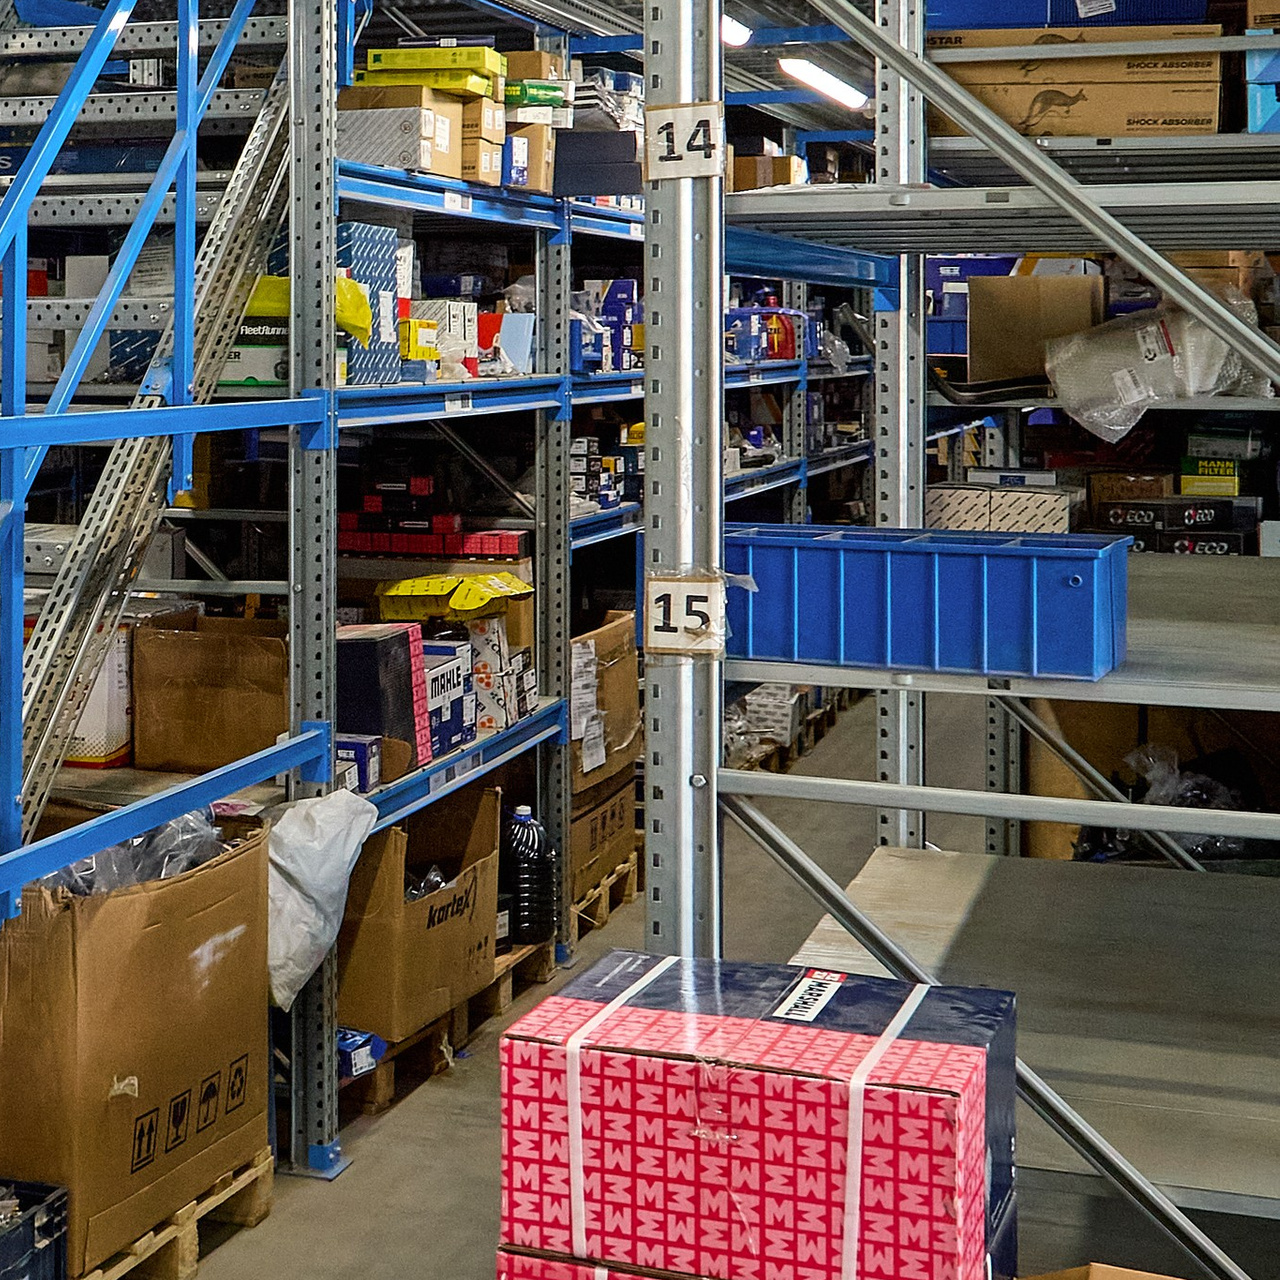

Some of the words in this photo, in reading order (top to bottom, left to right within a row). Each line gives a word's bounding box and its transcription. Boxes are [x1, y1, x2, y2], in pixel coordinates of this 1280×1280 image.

[657, 119, 717, 162] 14
[1198, 460, 1234, 468] MANN
[653, 594, 712, 633] 15
[431, 666, 462, 700] MAHLE
[784, 980, 831, 1017] MARSHALL
